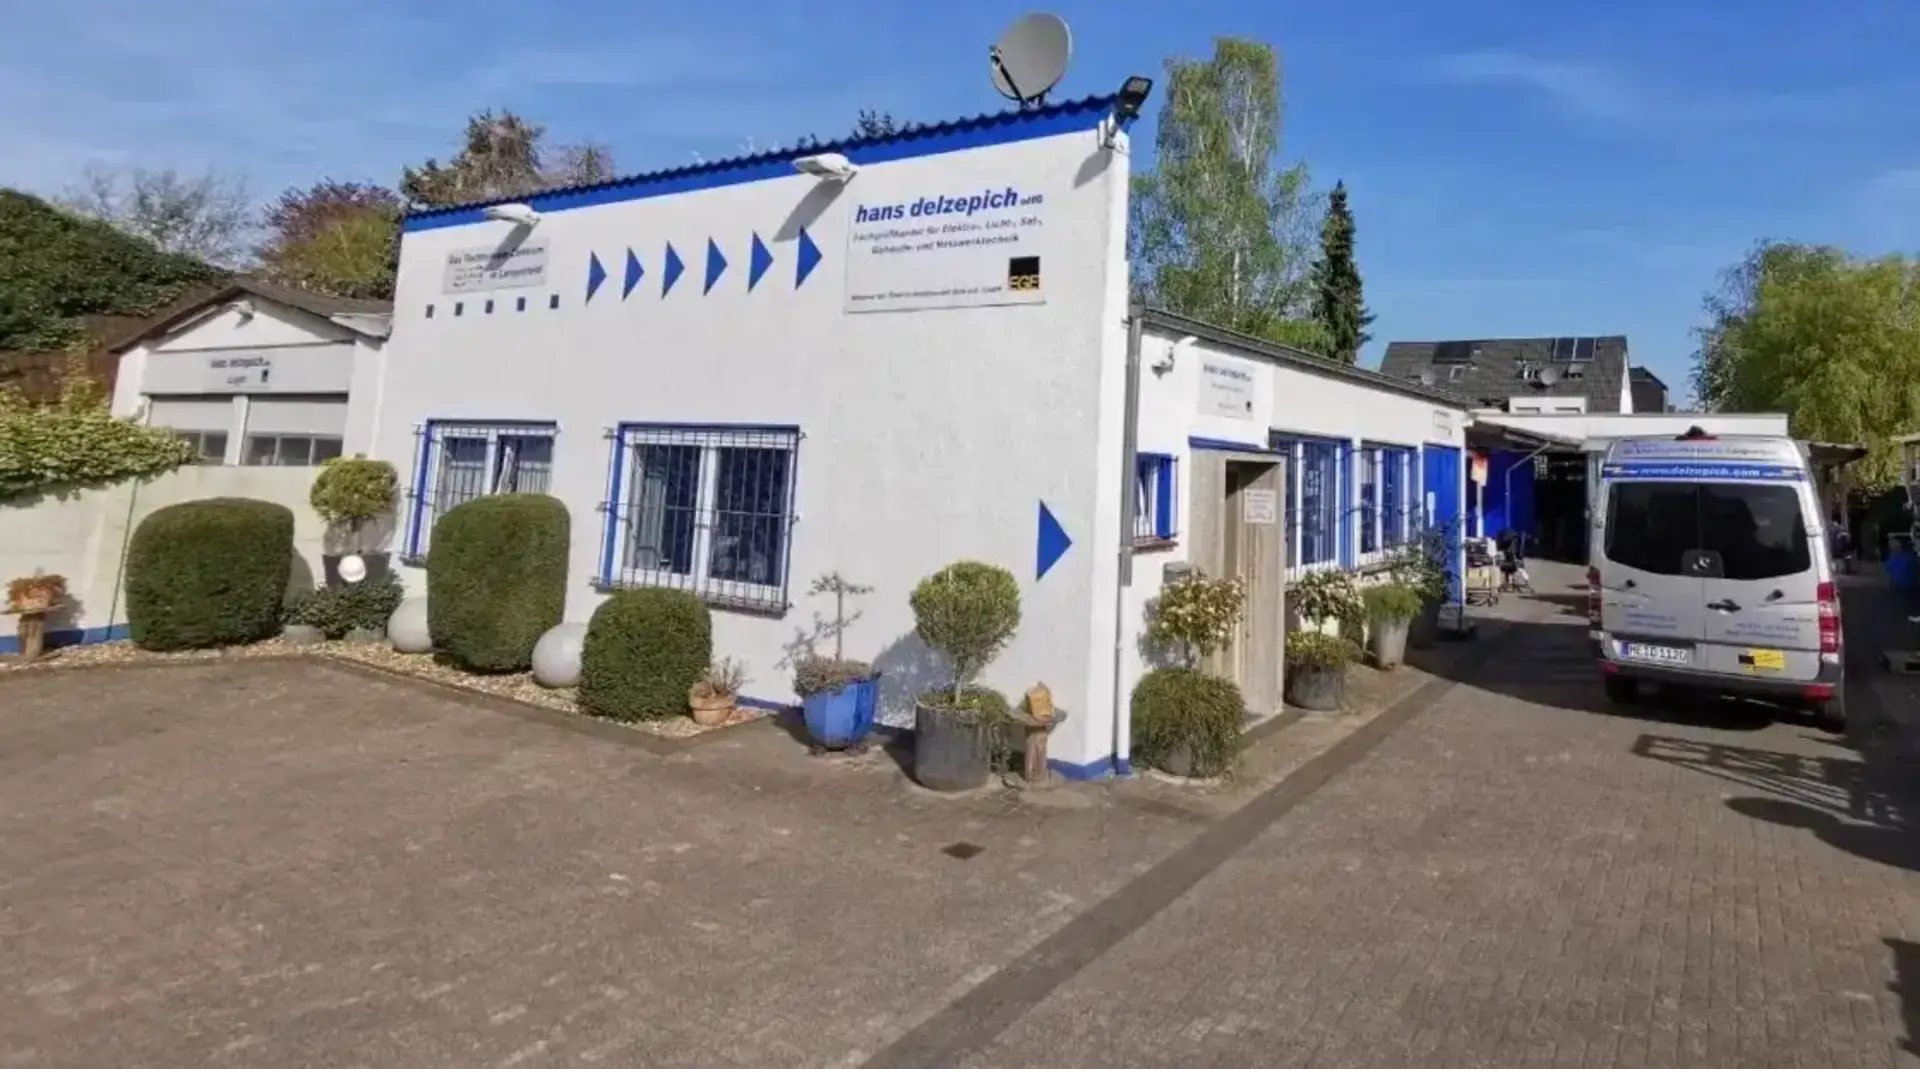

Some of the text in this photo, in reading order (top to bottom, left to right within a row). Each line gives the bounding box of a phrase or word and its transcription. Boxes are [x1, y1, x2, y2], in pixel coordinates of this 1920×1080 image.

[856, 204, 905, 223] hans
[910, 187, 1018, 217] delzepich
[1009, 274, 1039, 291] EGE
